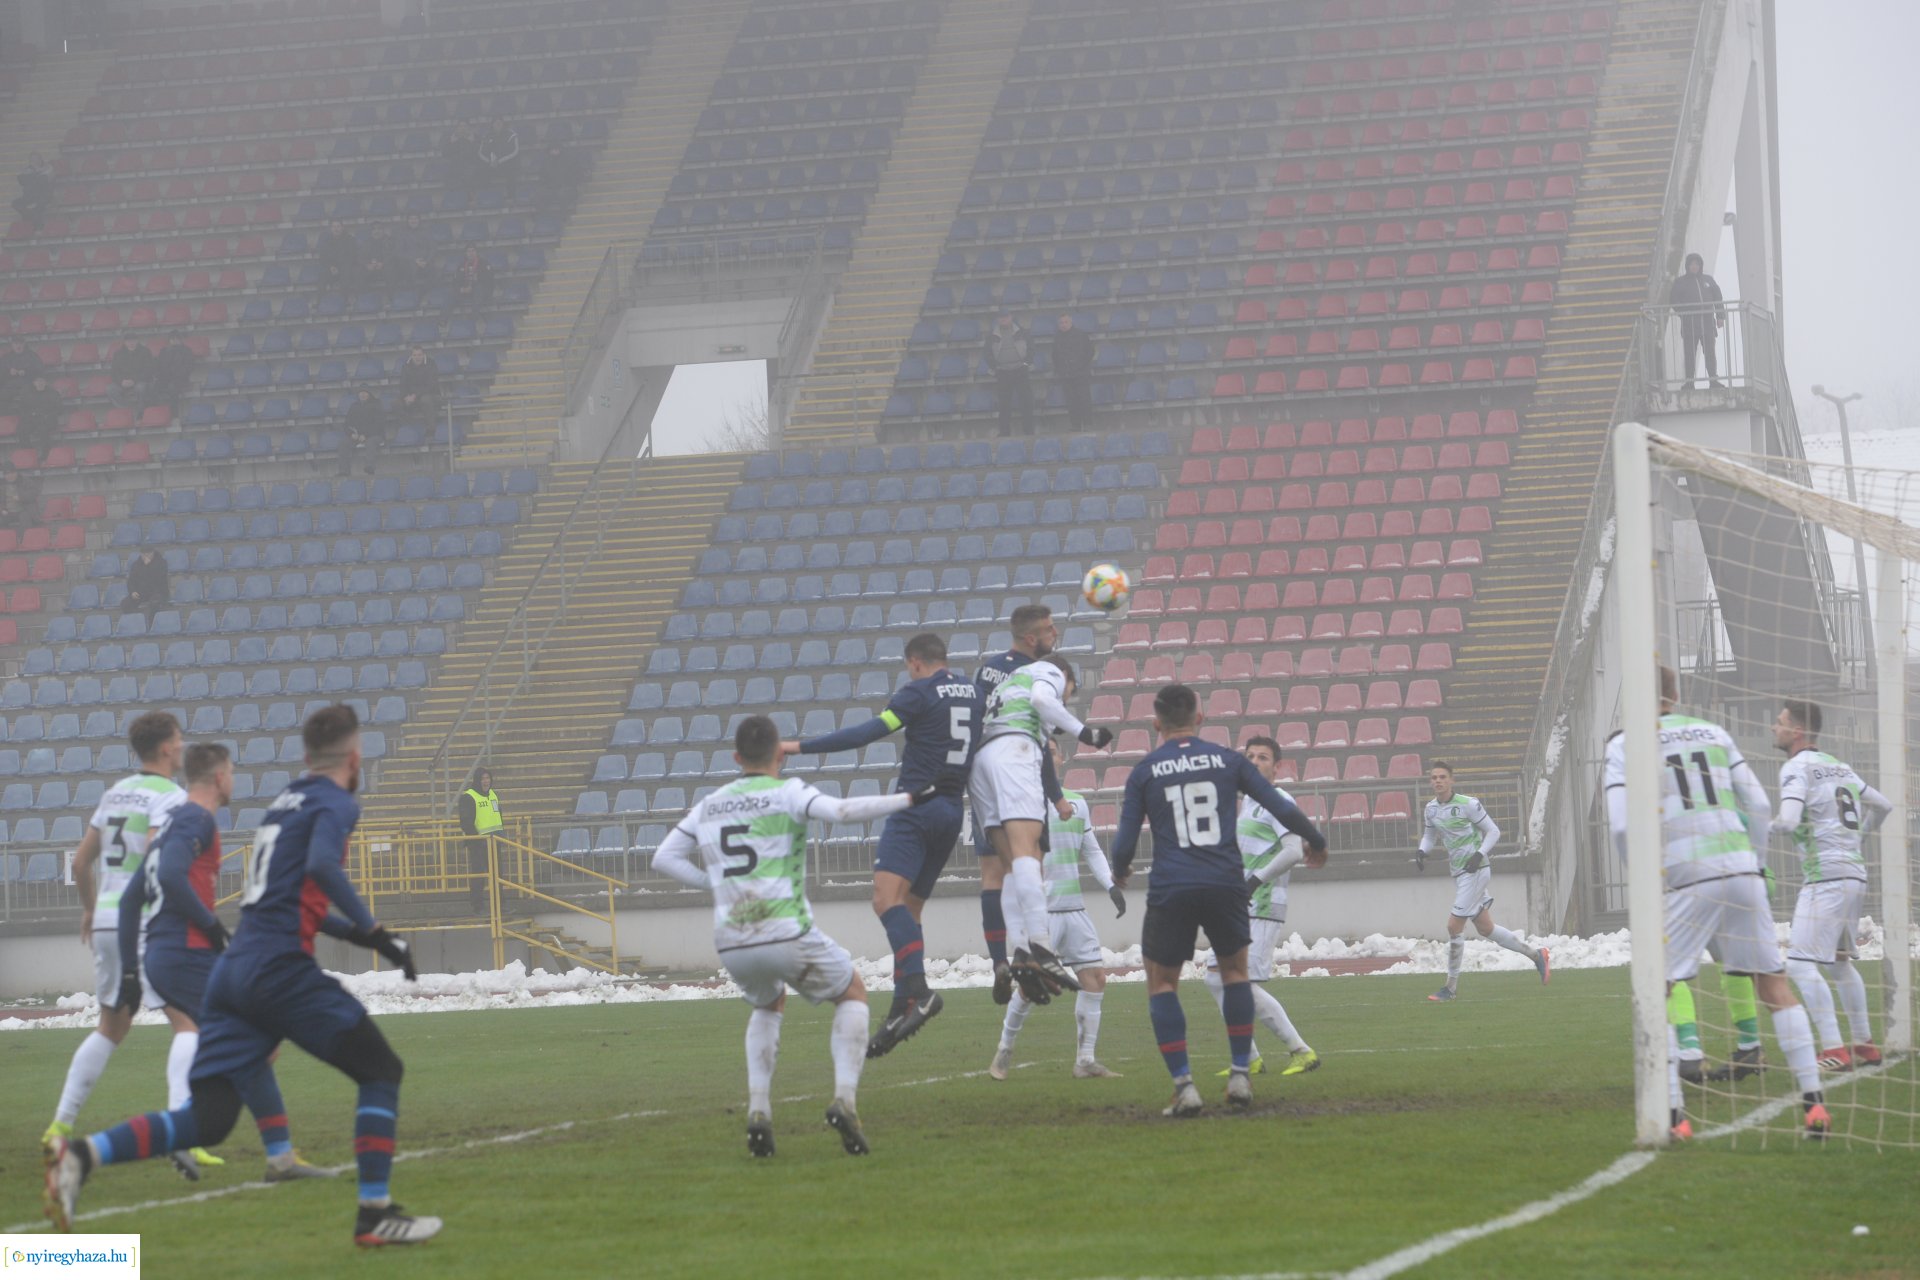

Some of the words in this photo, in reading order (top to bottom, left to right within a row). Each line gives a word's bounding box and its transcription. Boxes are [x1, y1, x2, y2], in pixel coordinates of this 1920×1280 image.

[936, 683, 977, 699] FODOR
[945, 706, 972, 766] 5
[1151, 754, 1211, 778] KOVÁCS
[1664, 751, 1720, 811] 11
[1163, 780, 1223, 849] 18
[1834, 786, 1860, 832] 8
[106, 815, 129, 868] 3
[721, 825, 758, 879] 5
